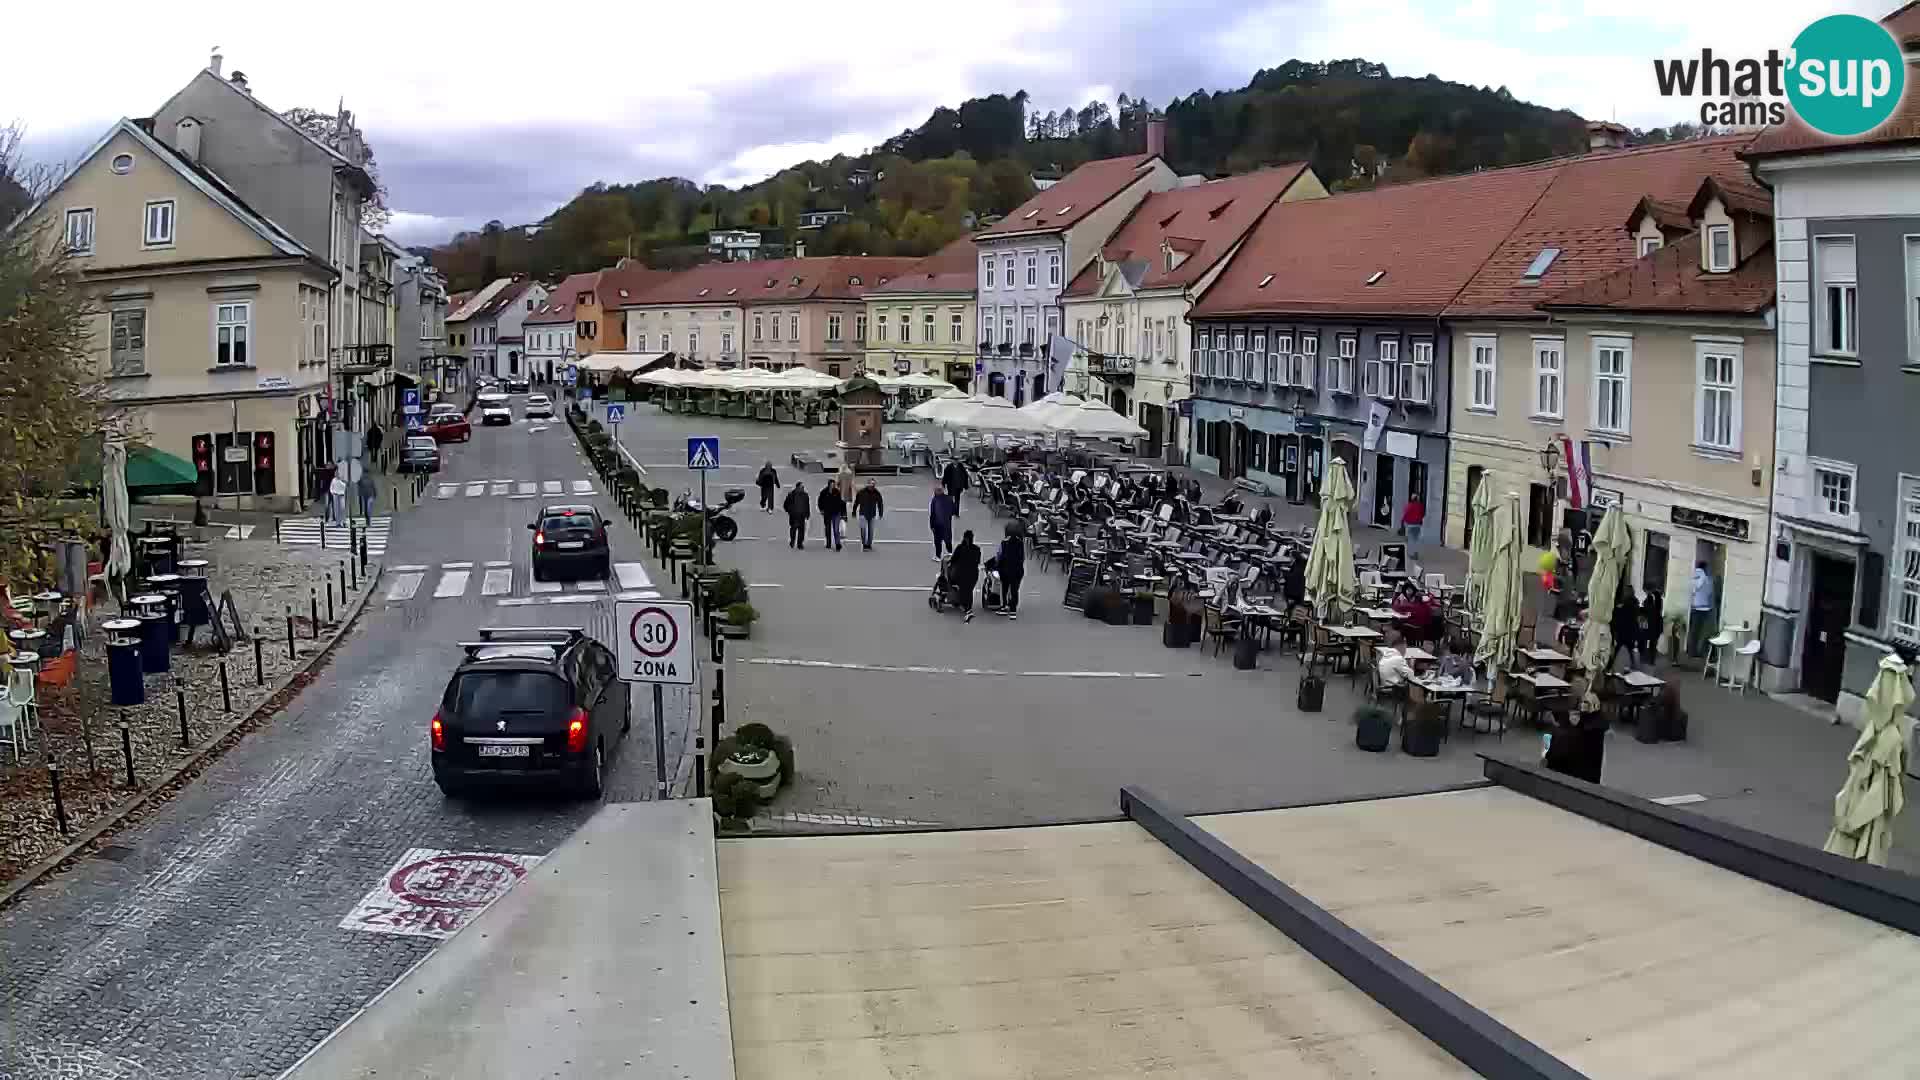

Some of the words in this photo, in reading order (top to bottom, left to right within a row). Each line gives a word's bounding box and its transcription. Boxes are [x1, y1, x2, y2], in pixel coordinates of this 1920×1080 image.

[643, 623, 667, 644] 30
[633, 660, 677, 677] ZONA
[357, 905, 466, 930] ZON
